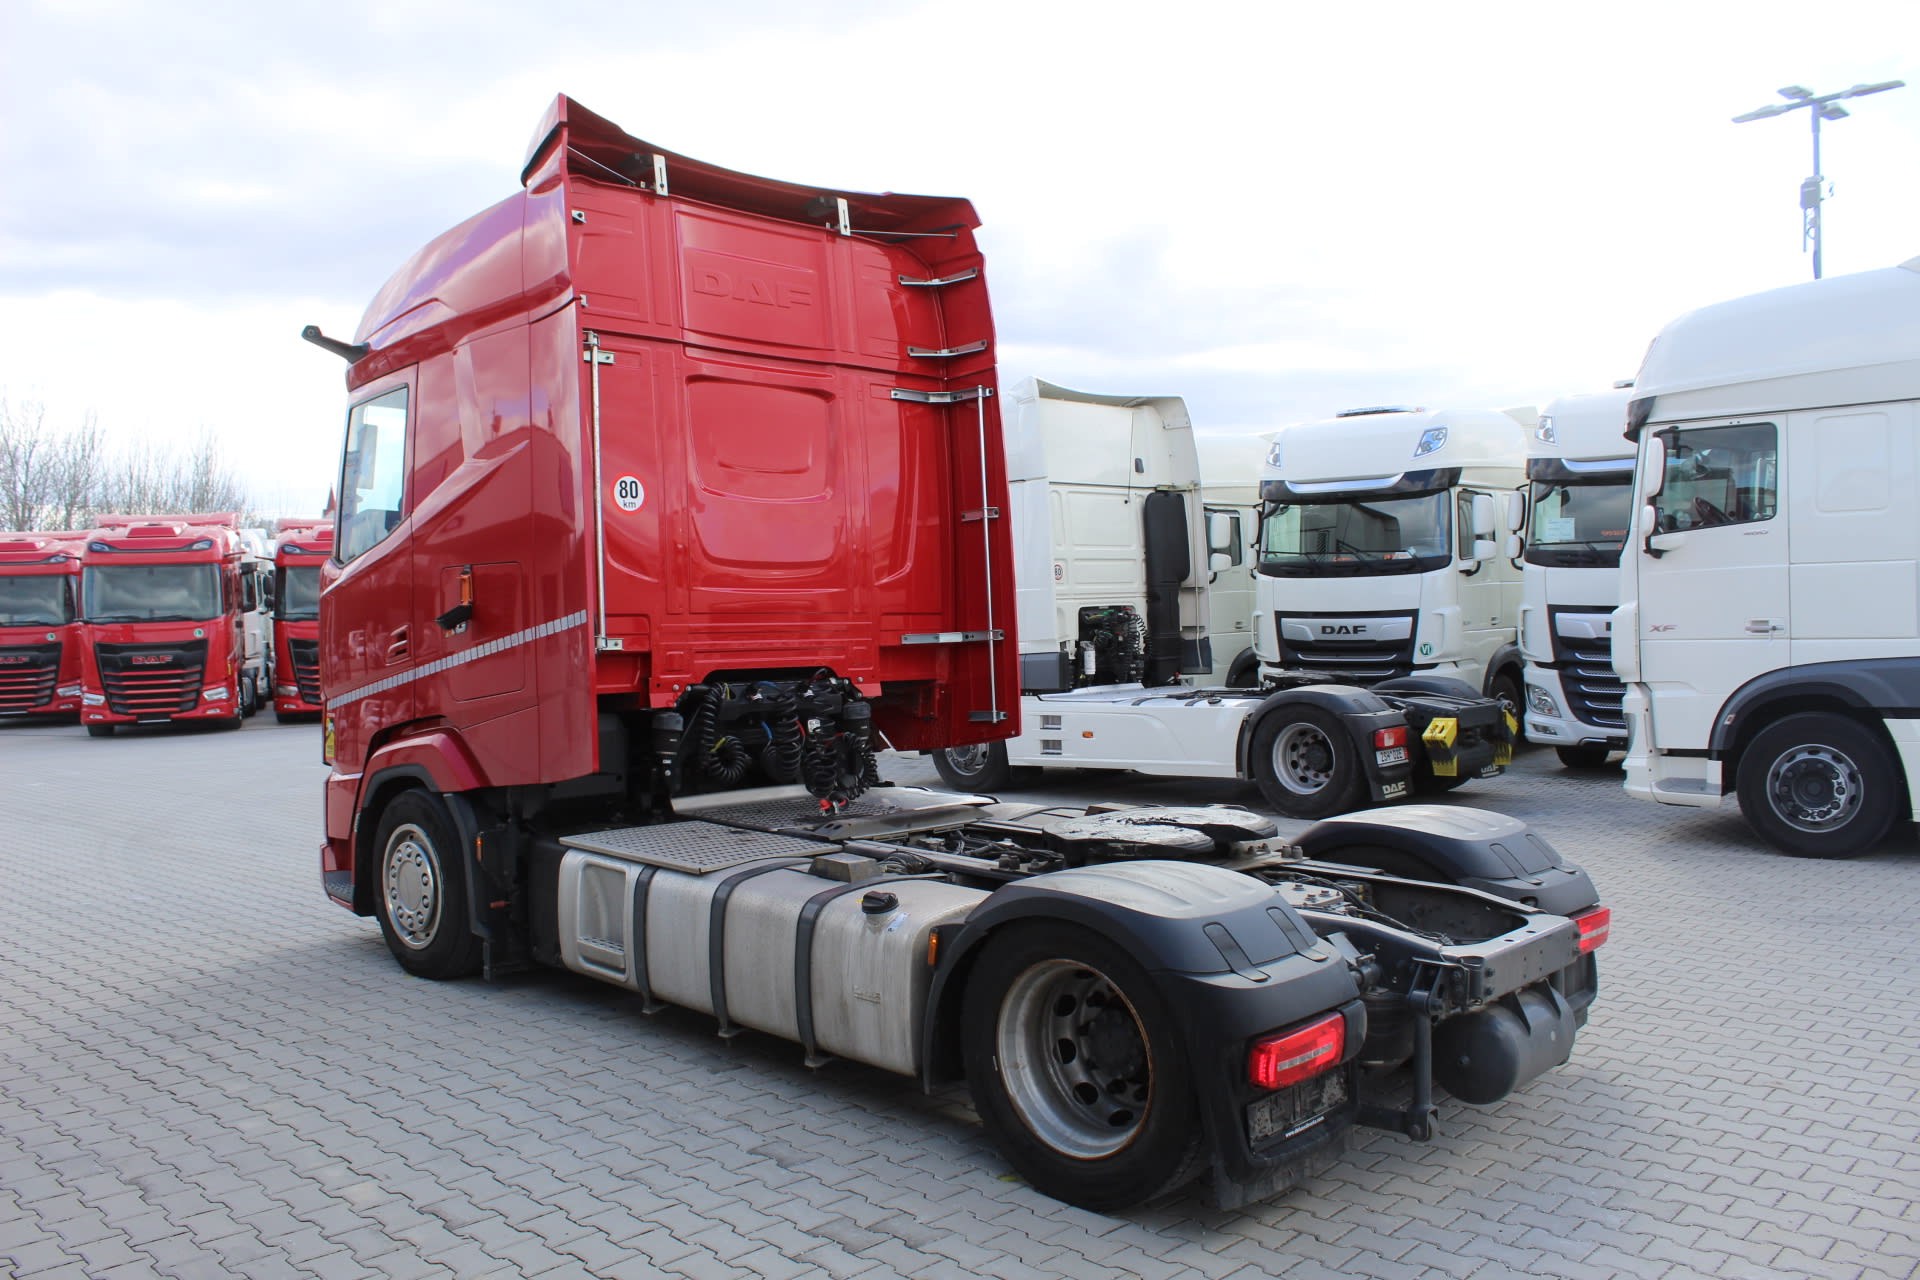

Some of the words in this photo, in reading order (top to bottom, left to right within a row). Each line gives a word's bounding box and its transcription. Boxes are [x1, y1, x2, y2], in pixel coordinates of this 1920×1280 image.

[690, 265, 813, 309] DAF
[619, 480, 639, 499] 80
[622, 500, 637, 509] km
[1320, 625, 1367, 635] DAF
[1648, 624, 1678, 633] XF
[132, 655, 173, 664] DAF
[1382, 781, 1406, 795] DAF
